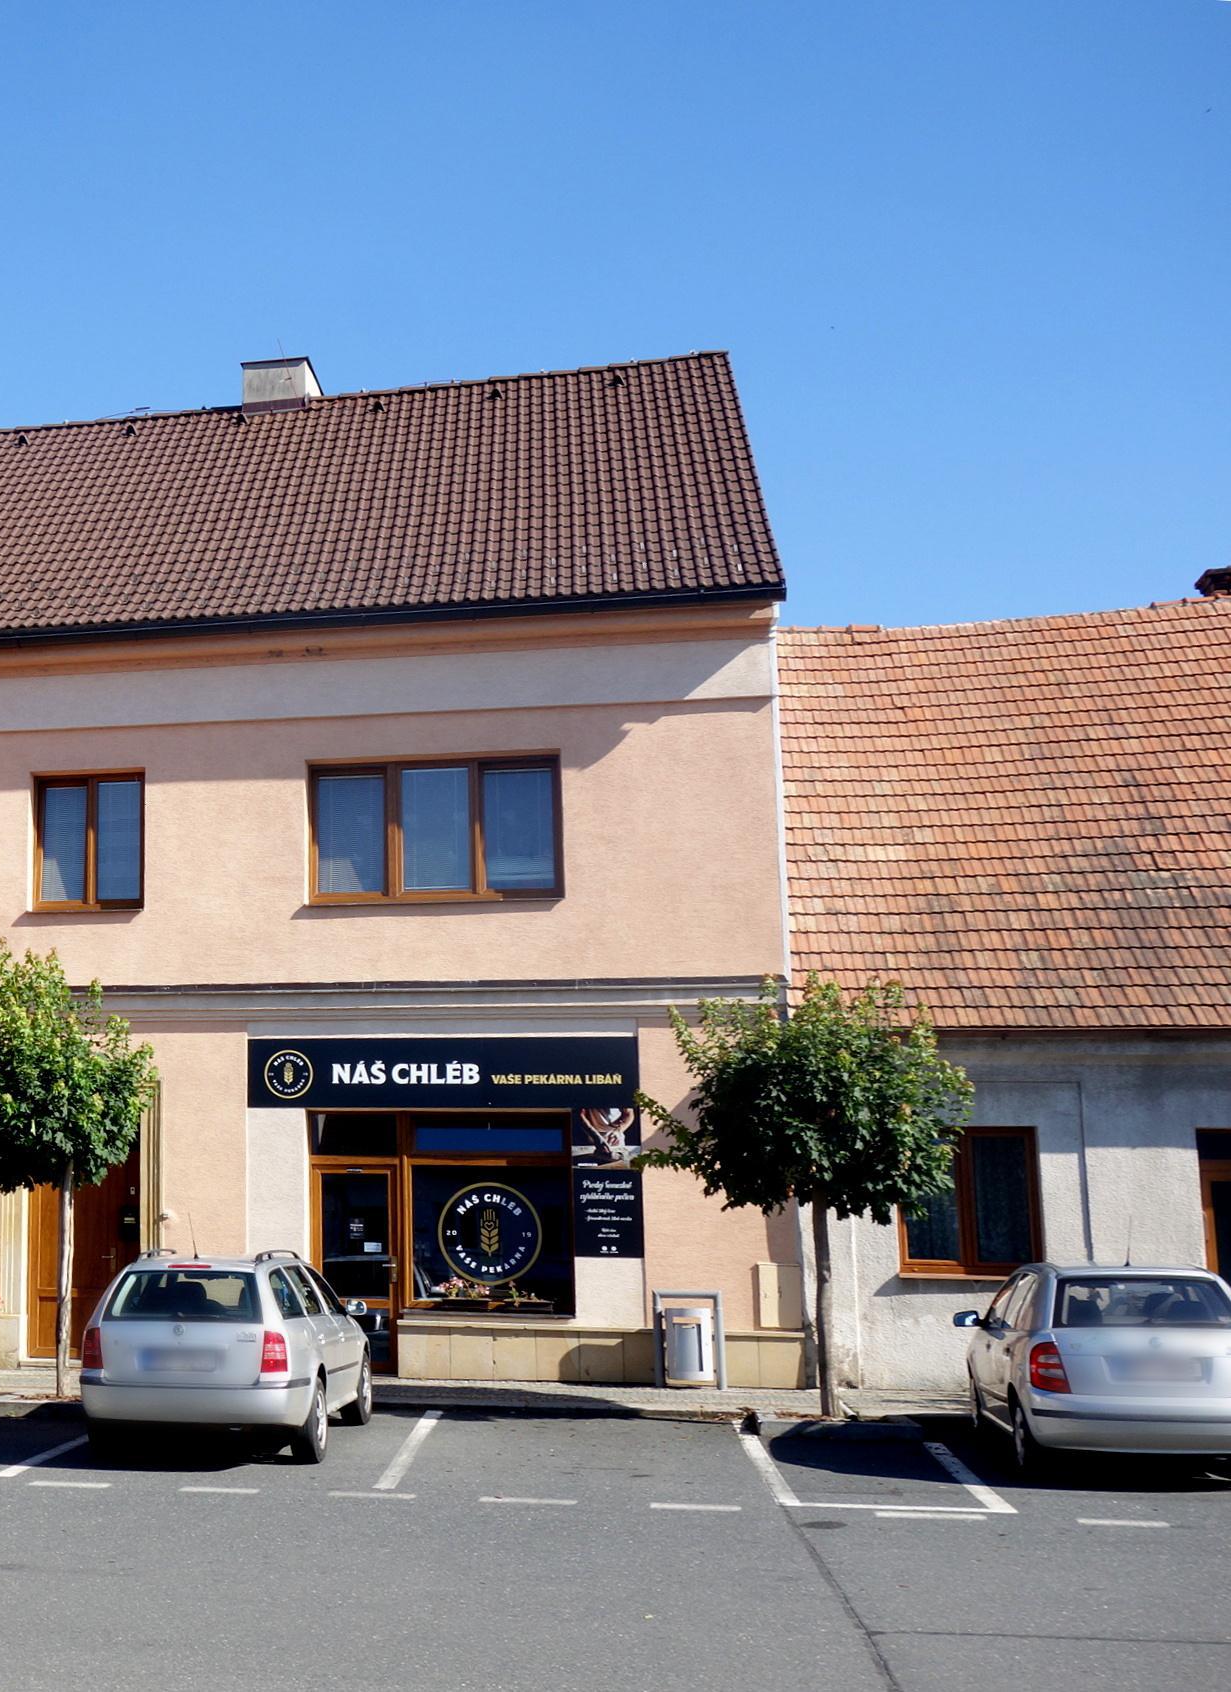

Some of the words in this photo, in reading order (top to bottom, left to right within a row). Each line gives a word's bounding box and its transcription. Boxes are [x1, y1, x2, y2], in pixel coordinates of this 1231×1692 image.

[331, 1060, 387, 1085] NÁŠ
[391, 1060, 480, 1085] CHLÉB
[491, 1073, 522, 1085] VAŠE
[524, 1073, 583, 1085] PEKÁRNA
